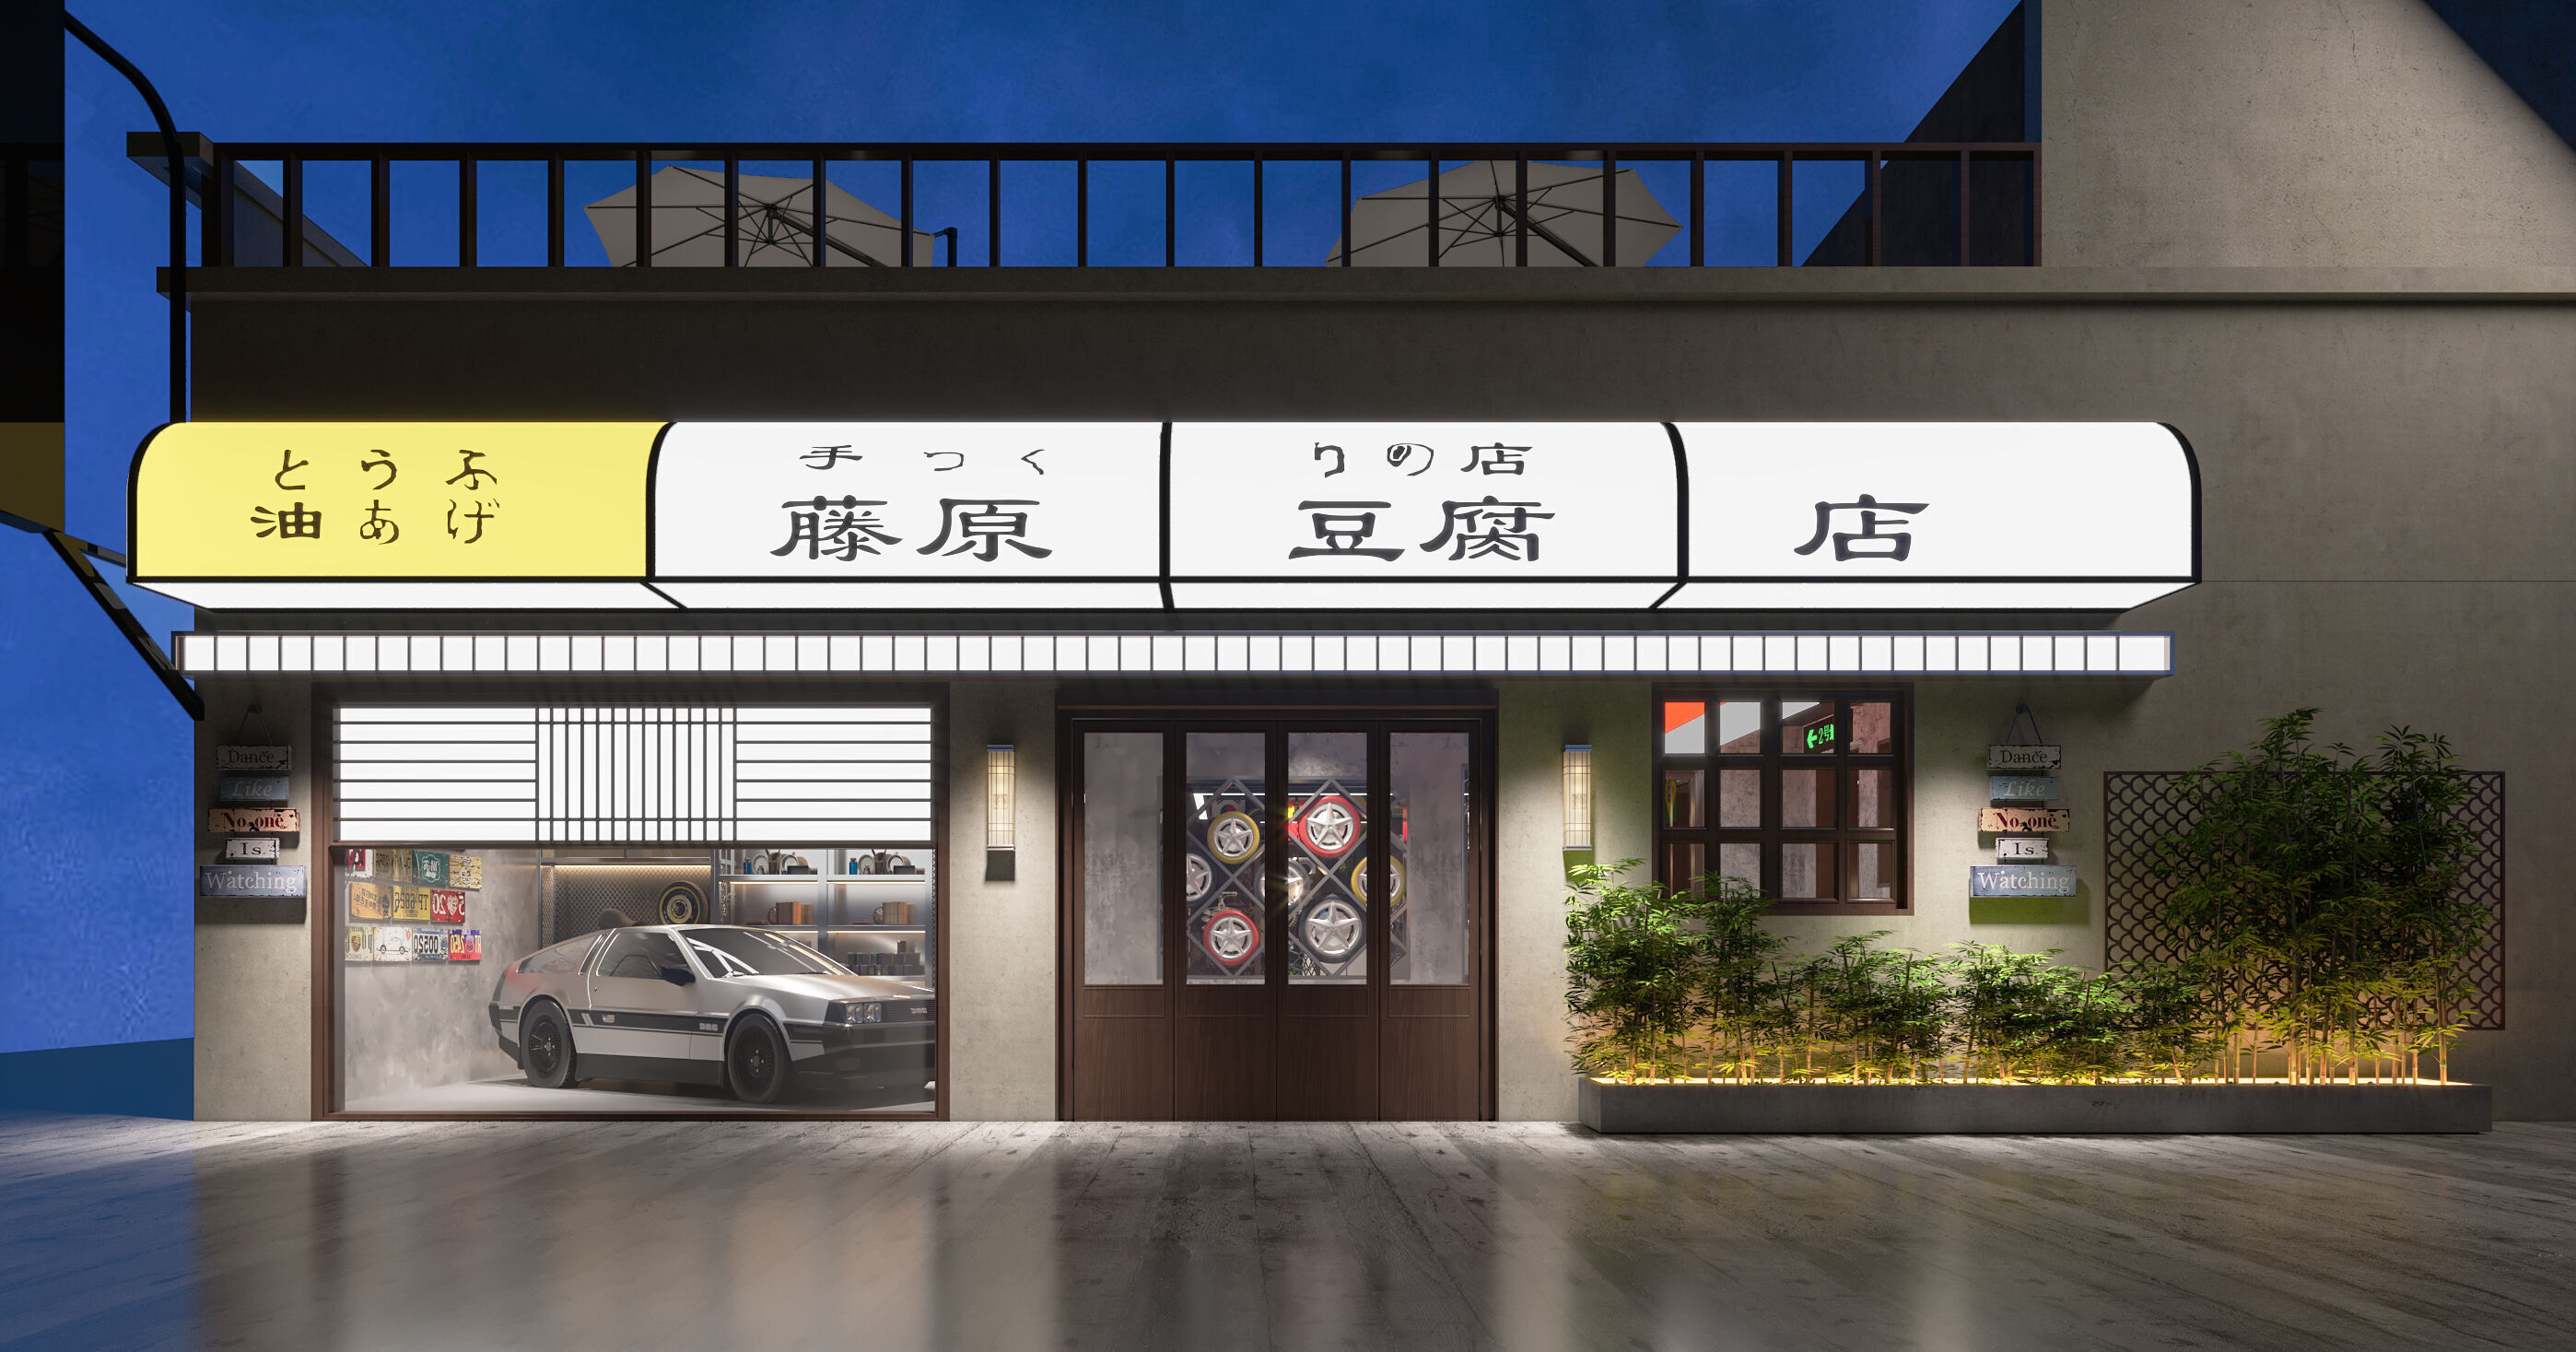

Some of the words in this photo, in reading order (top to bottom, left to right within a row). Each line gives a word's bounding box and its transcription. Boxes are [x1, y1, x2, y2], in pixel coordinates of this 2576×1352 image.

[275, 450, 497, 490] とうふ
[251, 499, 499, 545] 油あげ
[227, 749, 275, 764] Dance
[1999, 750, 2047, 764] Dance
[231, 781, 273, 796] Like
[2004, 781, 2045, 797] Like
[222, 812, 246, 829] No
[254, 817, 284, 829] one
[1996, 812, 2020, 829] No
[2027, 817, 2057, 829] one
[240, 842, 261, 855] Is
[2015, 842, 2034, 855] Is
[205, 871, 298, 894] Watching
[1977, 871, 2069, 893] Watching
